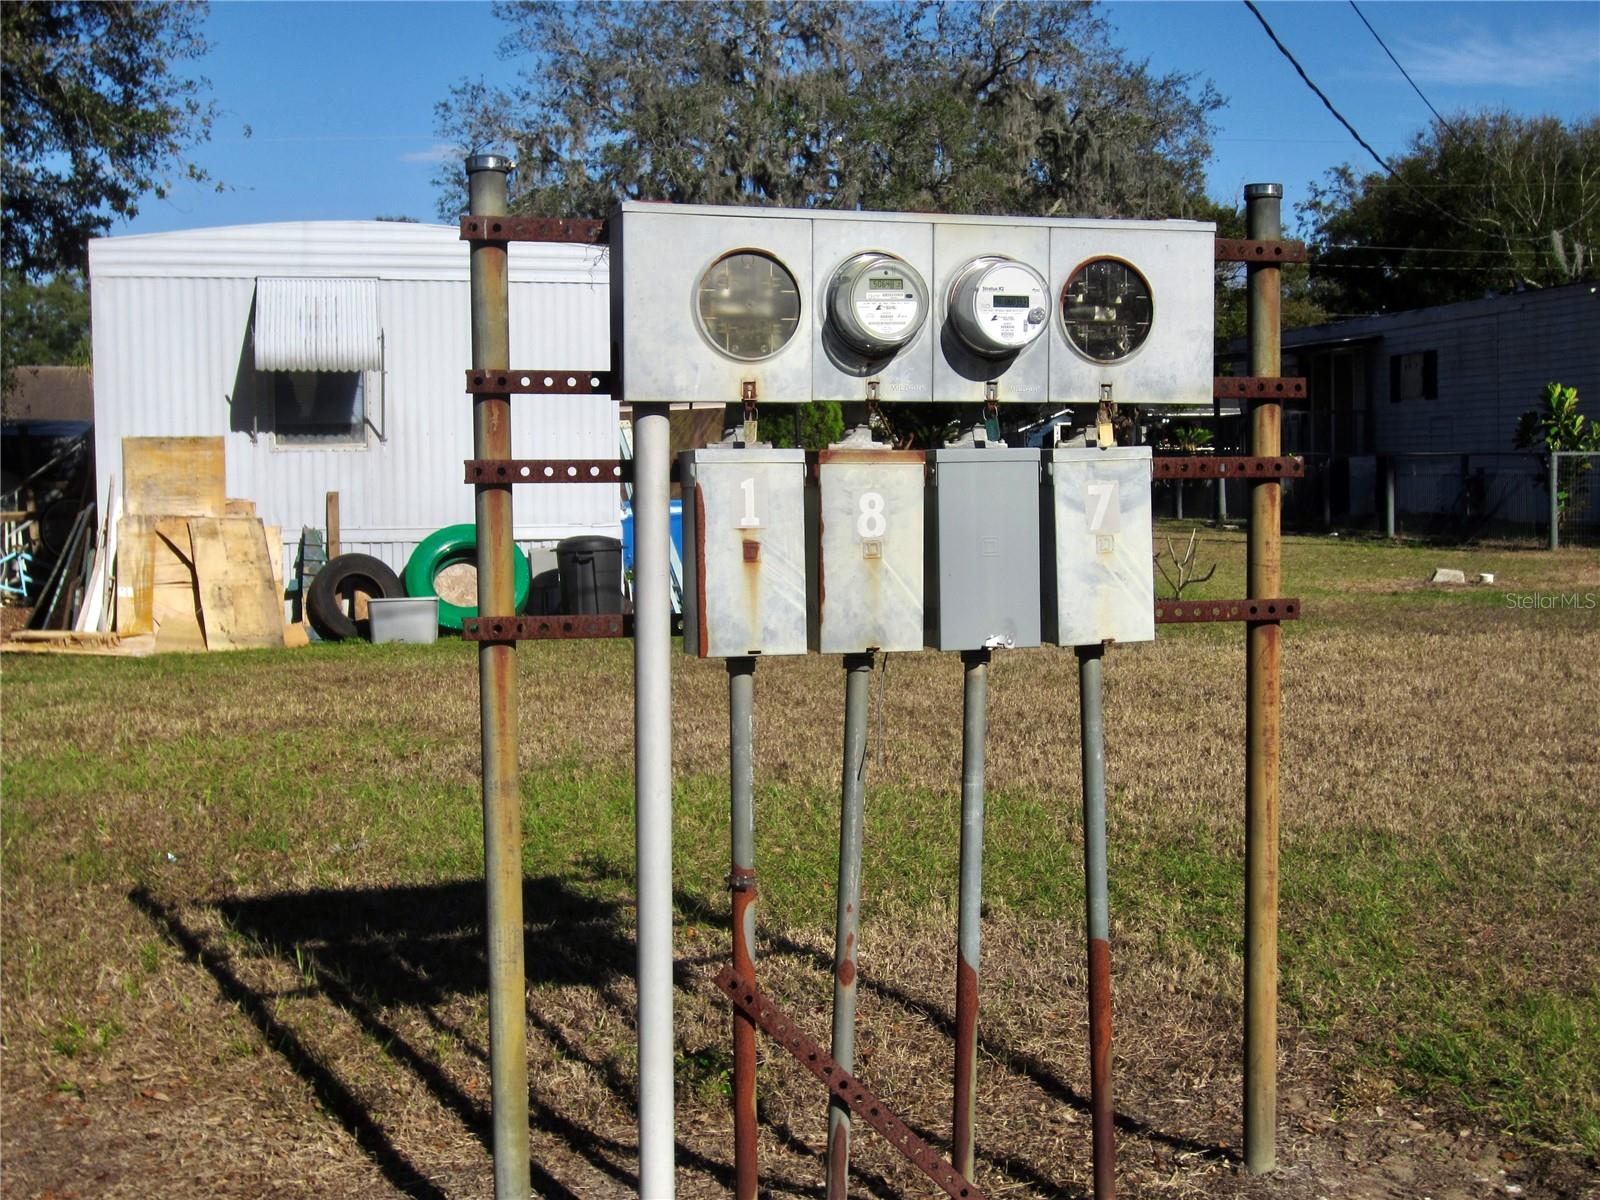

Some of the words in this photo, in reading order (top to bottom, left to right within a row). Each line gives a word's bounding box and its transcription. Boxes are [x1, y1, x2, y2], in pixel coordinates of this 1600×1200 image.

[740, 477, 760, 526] 1
[856, 491, 887, 537] 8
[1087, 484, 1117, 531] 7
